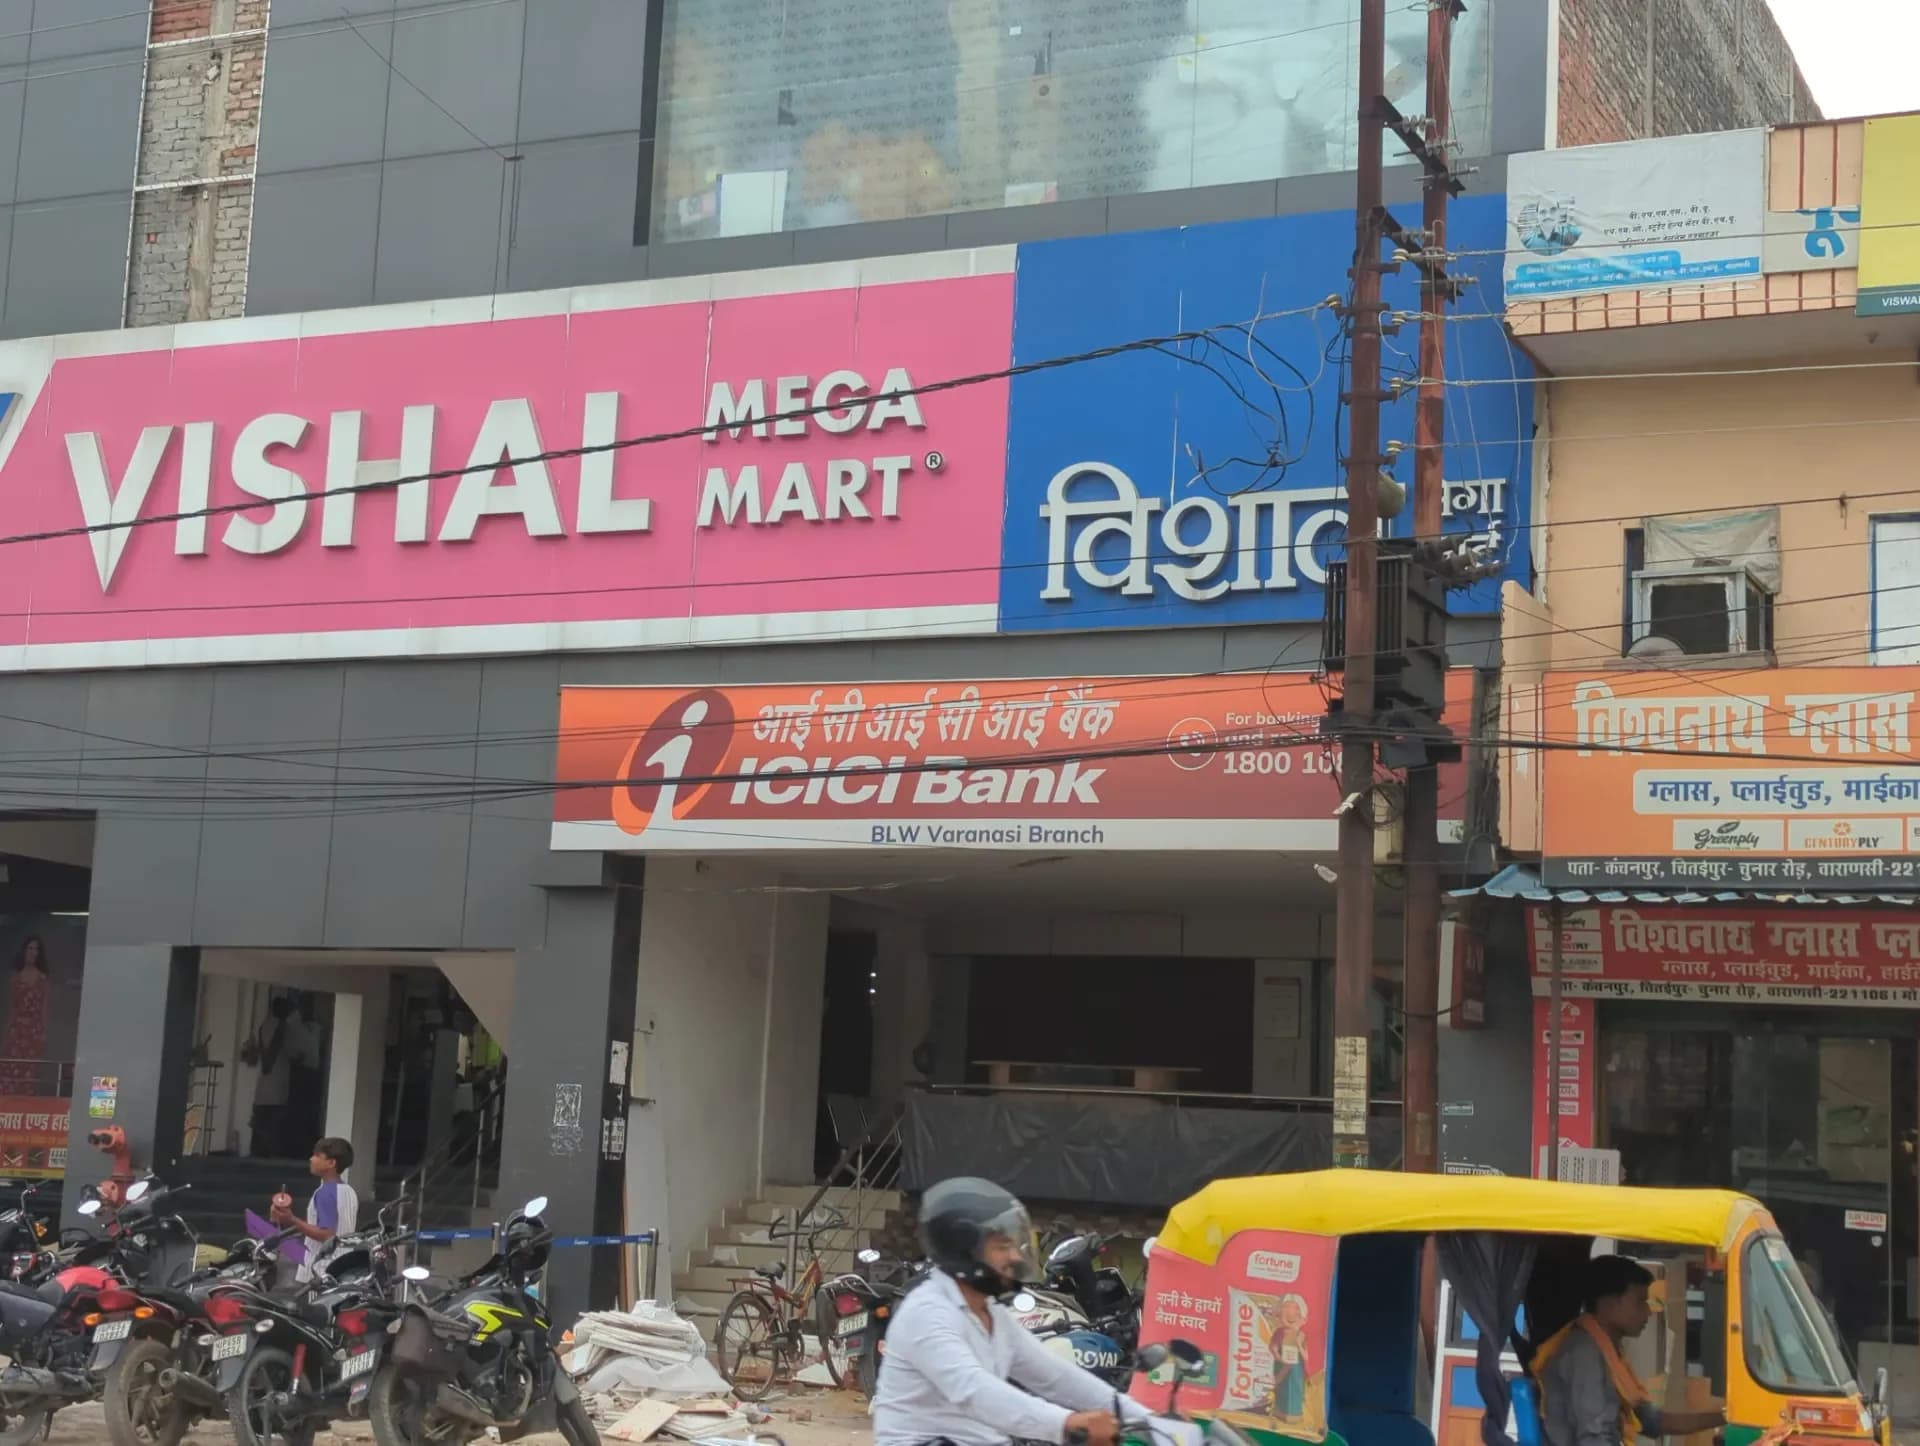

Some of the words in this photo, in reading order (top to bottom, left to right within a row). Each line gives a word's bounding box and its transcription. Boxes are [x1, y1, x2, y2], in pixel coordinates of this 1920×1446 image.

[1882, 295, 1920, 307] VISWA
[704, 367, 927, 443] MEGA
[64, 391, 651, 595] VISHAL
[697, 455, 914, 529] MART
[753, 689, 824, 751] आई
[822, 688, 866, 743] सी
[865, 687, 938, 750] आई
[936, 686, 982, 742] सी
[983, 685, 1059, 749] आई
[1058, 683, 1121, 741] बैंक
[1225, 712, 1251, 726] For
[1256, 711, 1321, 729] banking
[1571, 680, 1770, 758] विश्वनाथ
[1785, 692, 1914, 755] ग्लास
[1223, 751, 1291, 775] 1800
[729, 755, 905, 805] ICICI
[911, 755, 1108, 805] Bank
[1648, 779, 1720, 807] ग्लास,
[1730, 774, 1832, 810] प्लाईवुड,
[870, 824, 921, 844] BLW
[926, 824, 1022, 844] Varanasi
[1027, 824, 1105, 844] Branch
[1693, 827, 1760, 850] Greenply
[1804, 836, 1880, 849] CENTURYPLY
[1567, 861, 1600, 876] पता-
[1738, 860, 1778, 881] चुनार
[1817, 857, 1920, 878] वाराणसी-22
[1610, 907, 1755, 955] विश्वनाथ
[1765, 922, 1861, 958] ग्लास
[1253, 1253, 1294, 1271] fortune
[1180, 1291, 1194, 1310] के
[1229, 1302, 1254, 1401] fortune
